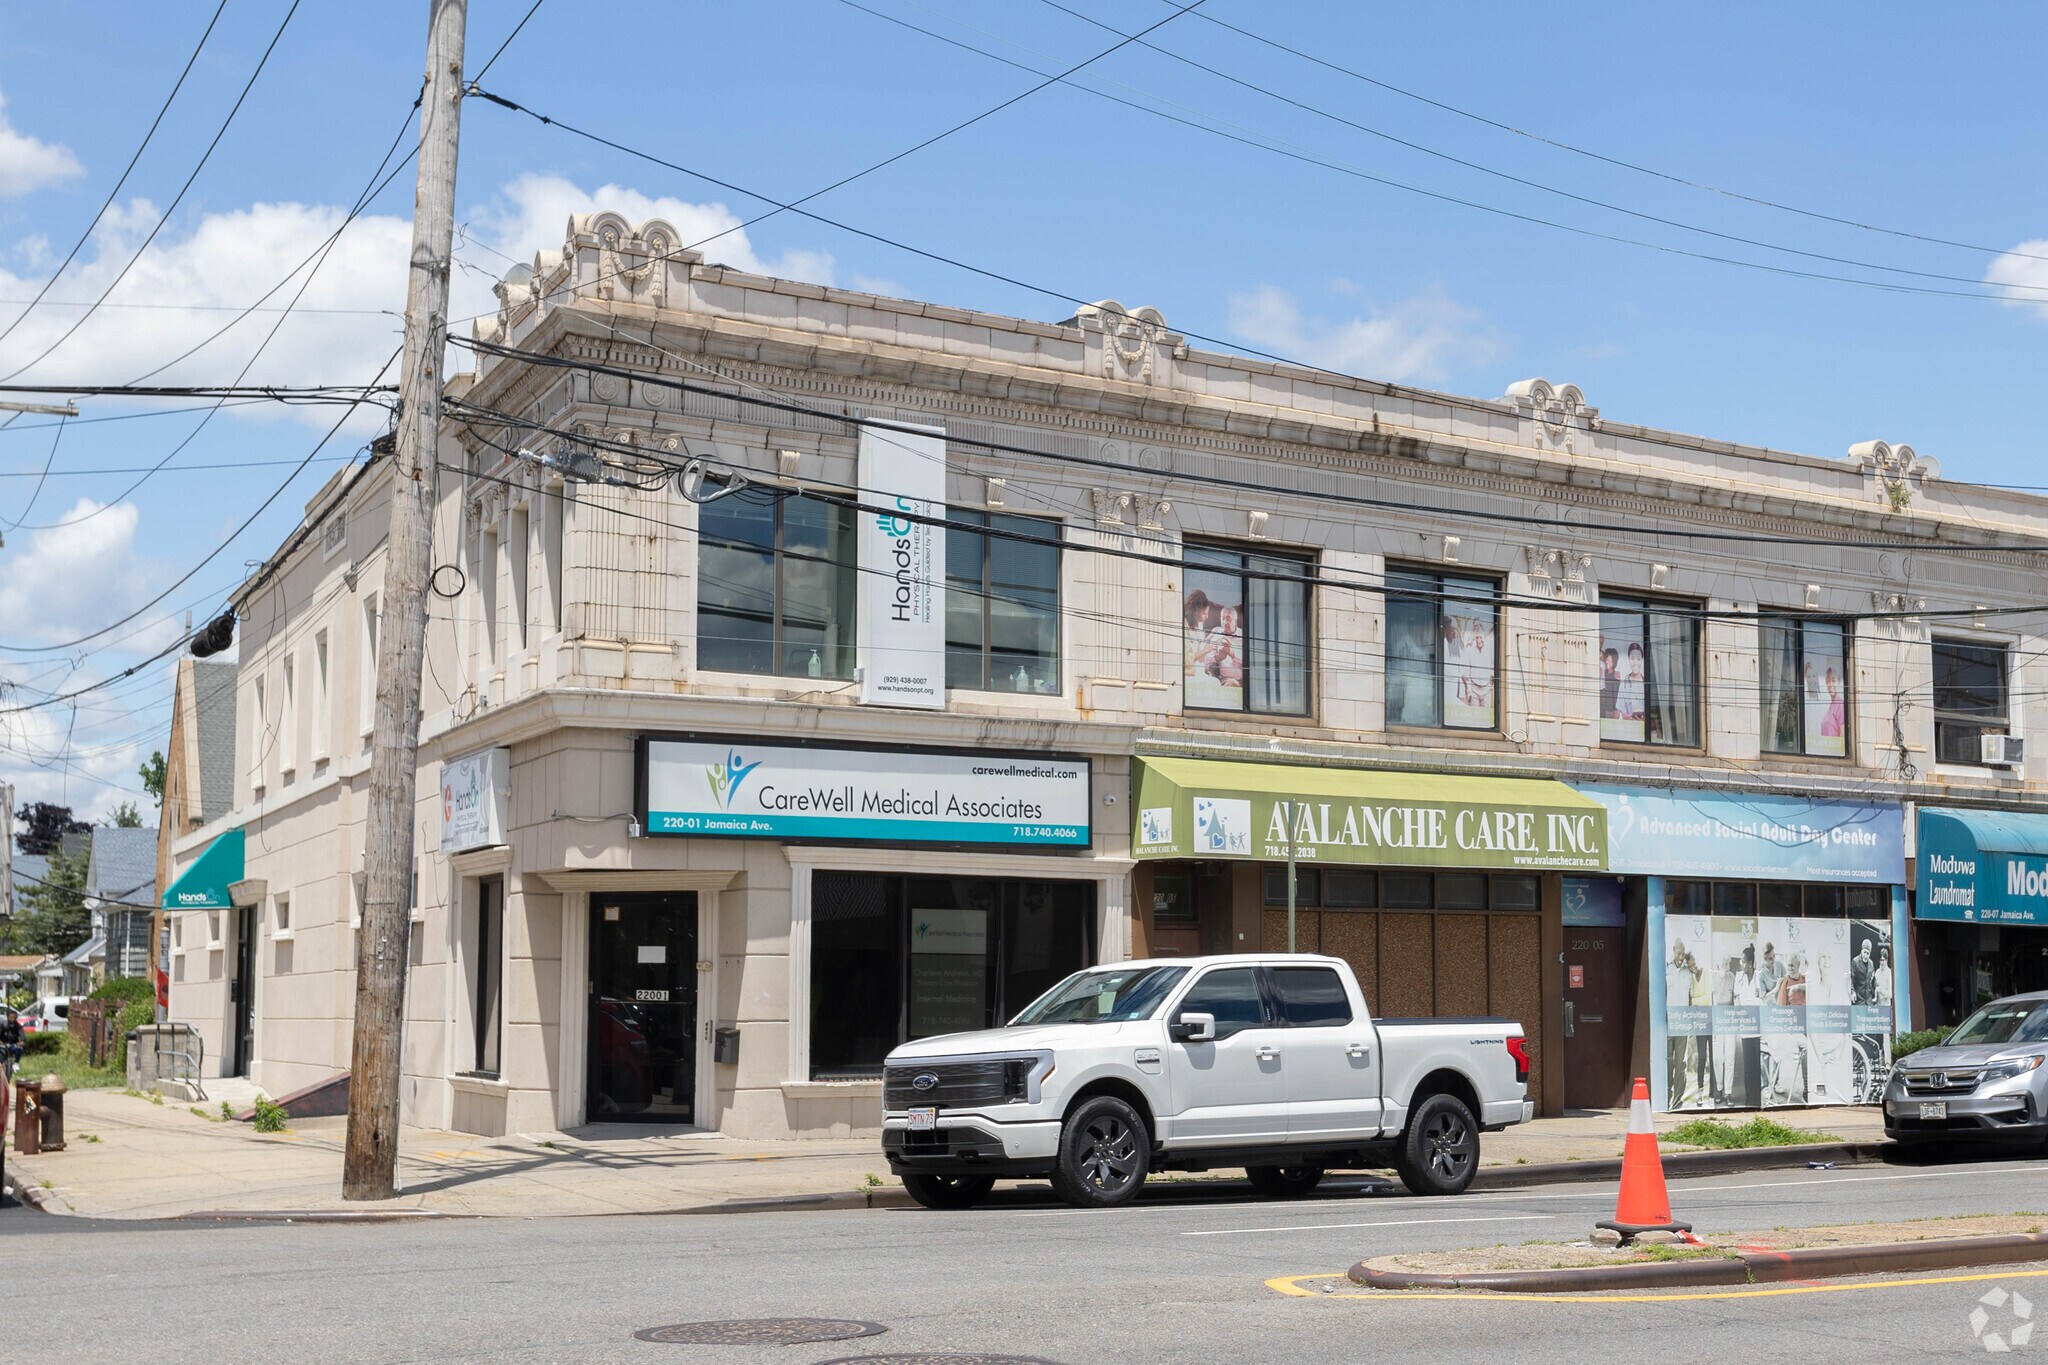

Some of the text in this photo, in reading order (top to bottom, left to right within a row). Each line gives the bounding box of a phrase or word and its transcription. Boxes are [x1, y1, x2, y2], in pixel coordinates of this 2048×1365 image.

[883, 676, 928, 685] (929) 438-0007
[877, 685, 934, 695] www.handsonpt.org
[972, 765, 1078, 780] carewellmedical.com
[758, 785, 1042, 820] CareWell Medical Associates
[663, 816, 773, 831] 220-01 Jamaica Ave.
[1265, 801, 1599, 854] AVALANCHE CARE, INC.
[1013, 826, 1077, 839] 718.740.4066
[1640, 816, 1877, 848] Advanced Social Adult Day Center
[1265, 845, 1316, 858] 718.45.2038
[1513, 854, 1600, 867] www.avalanchecare.com
[1929, 854, 1975, 875] Moduwa
[1806, 866, 1820, 875] Most
[1851, 868, 1877, 878] accepted
[1929, 879, 1975, 906] Laundromat
[2000, 910, 2022, 919] Jamaica
[1571, 939, 1604, 950] 220 05
[637, 991, 668, 1000] 22001
